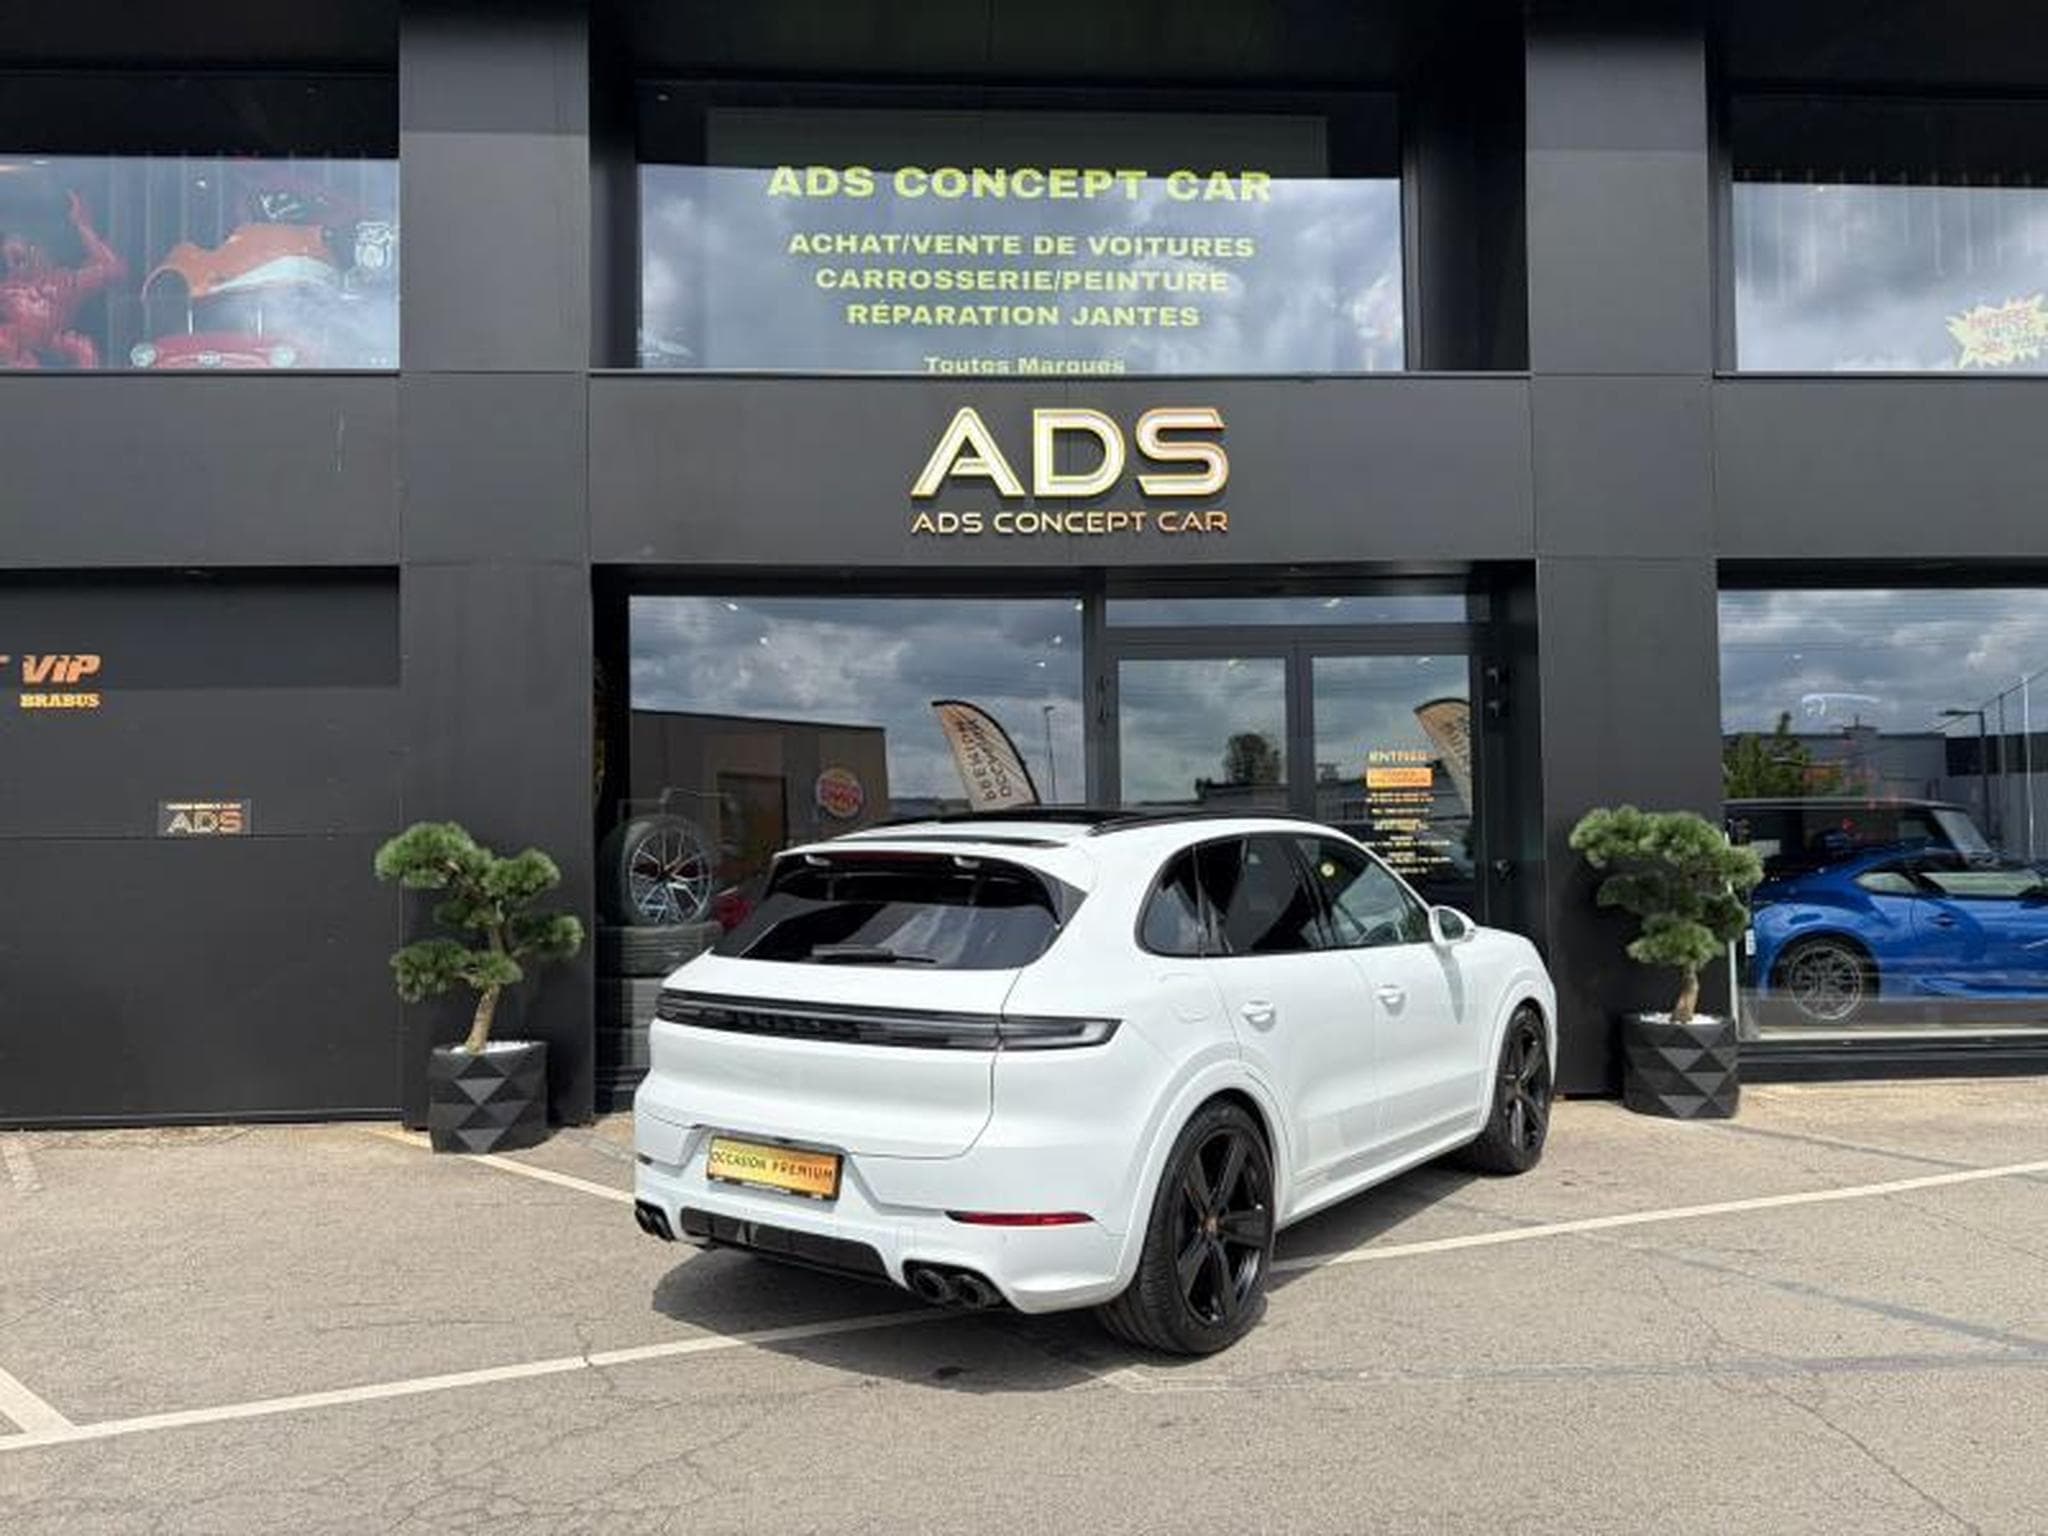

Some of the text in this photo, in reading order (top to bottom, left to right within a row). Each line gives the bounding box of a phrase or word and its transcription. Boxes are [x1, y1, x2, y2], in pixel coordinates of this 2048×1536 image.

[767, 166, 1271, 201] ADS CONCEPT CAR
[788, 234, 1255, 258] ACHAT/VENTE DE VOITURES
[815, 268, 1230, 292] CARROSSERIE/PEINTURE
[847, 299, 1201, 327] RÉPARATION JANTES
[924, 356, 1009, 375] Toutes
[910, 405, 1229, 497] ADS
[911, 510, 1228, 534] ADS CONCEPT CAR
[20, 693, 101, 708] BRABUS
[166, 811, 243, 834] ADS
[711, 1151, 833, 1180] OCCASION PREMIUM
